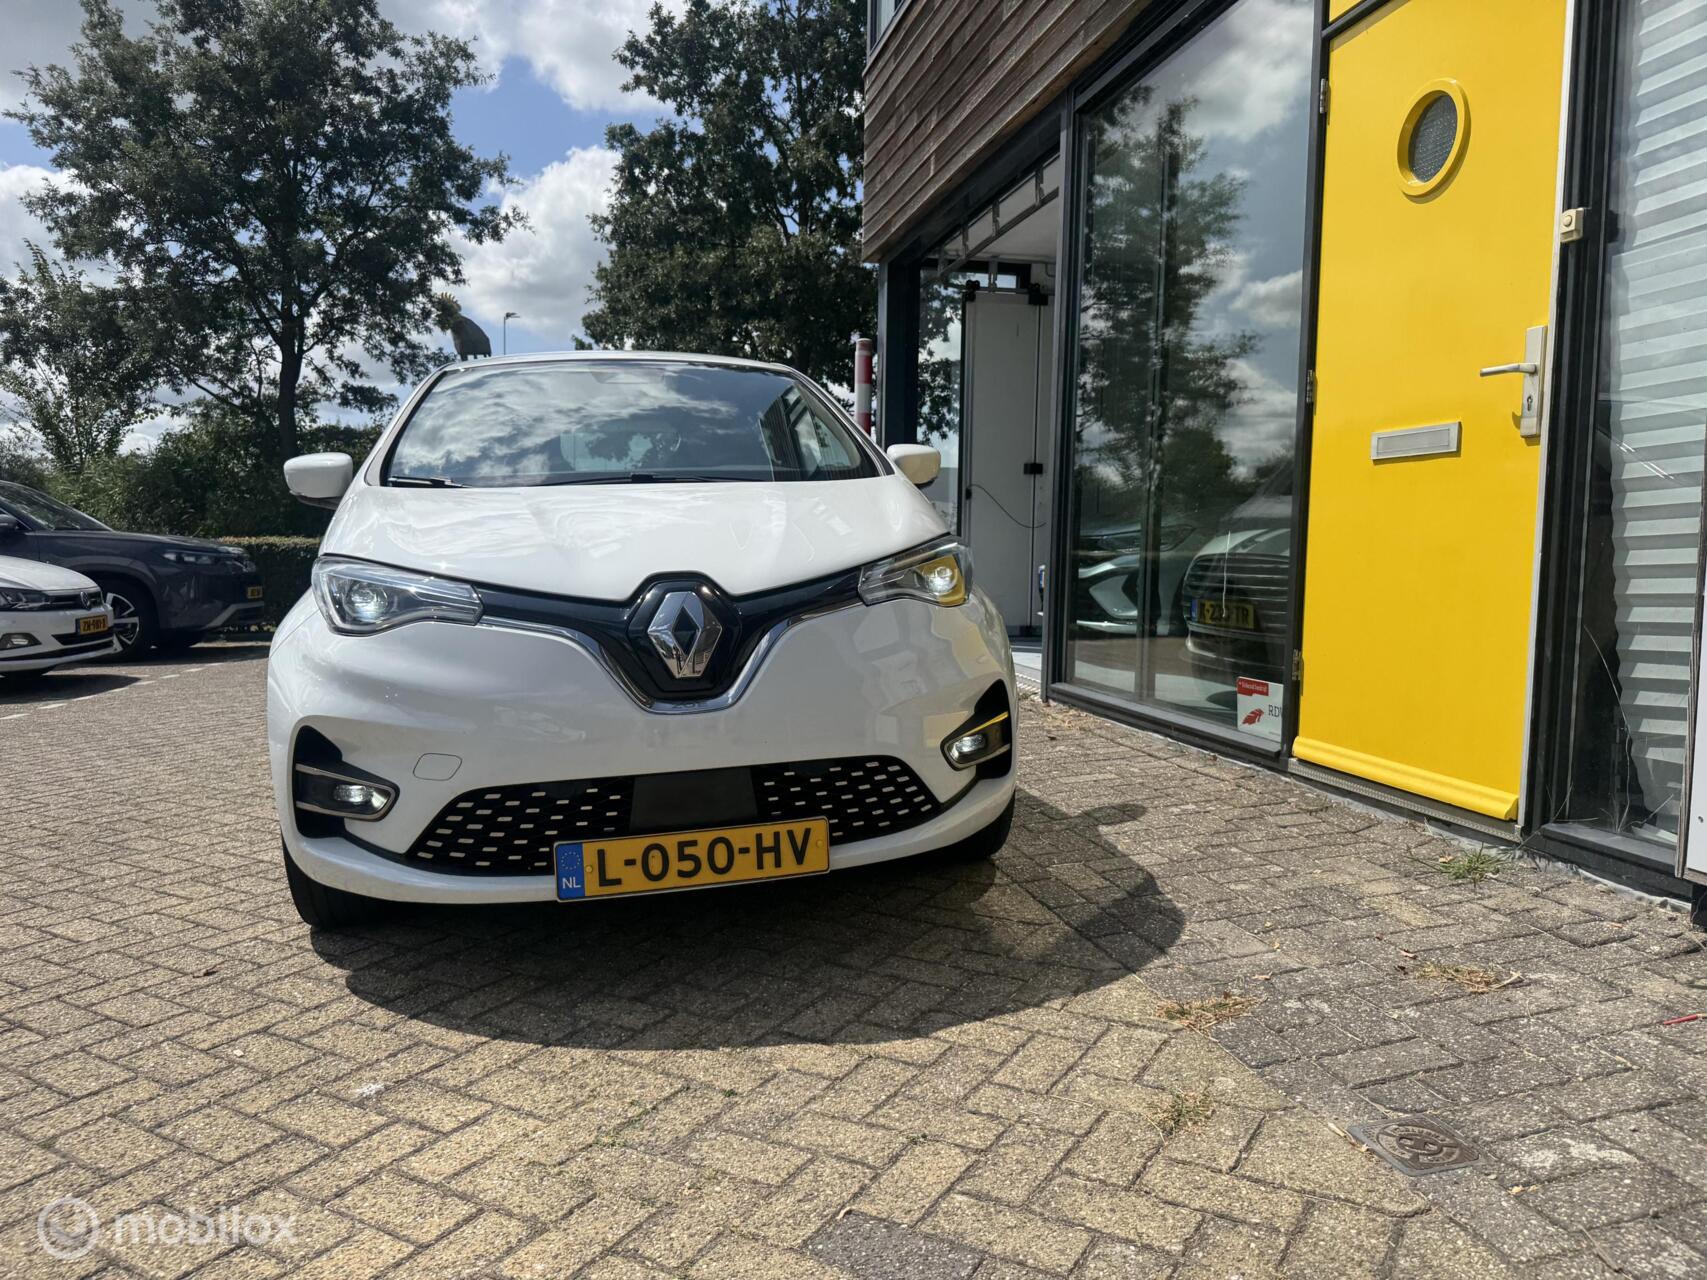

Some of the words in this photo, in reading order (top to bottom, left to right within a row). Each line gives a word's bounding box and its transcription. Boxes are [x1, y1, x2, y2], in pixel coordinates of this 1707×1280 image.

[1268, 704, 1282, 718] RD
[597, 827, 812, 888] L-050-HV
[562, 876, 582, 890] NL
